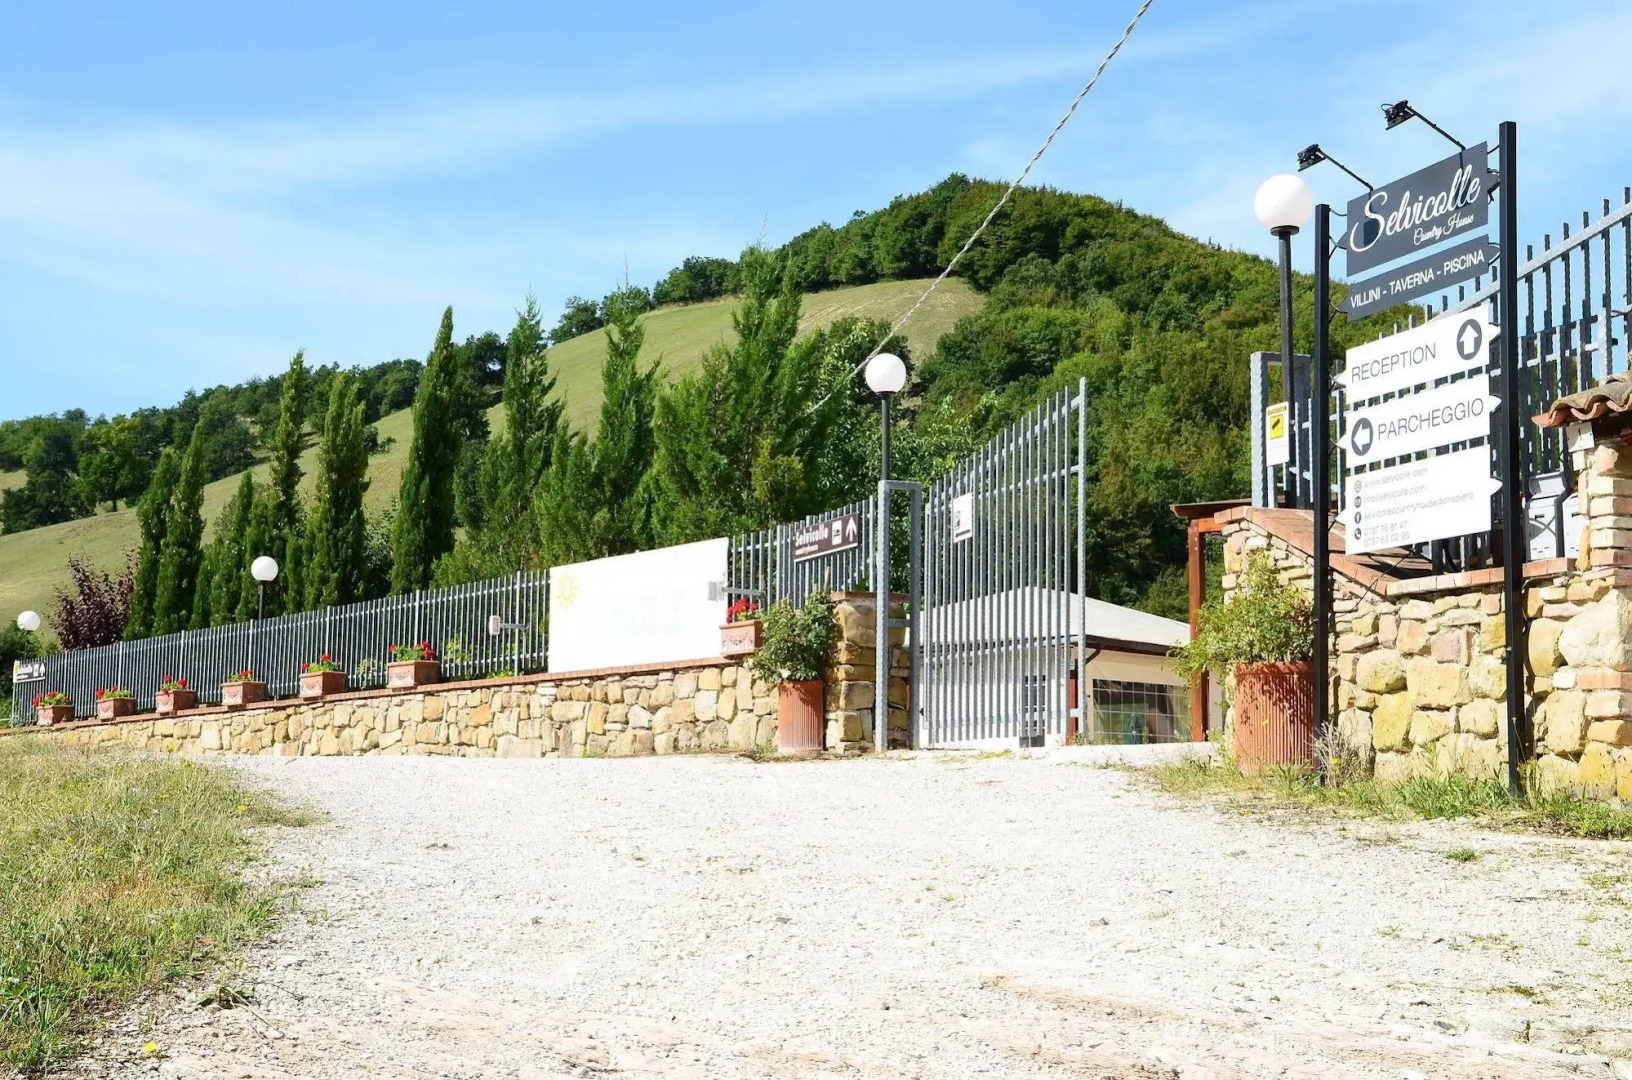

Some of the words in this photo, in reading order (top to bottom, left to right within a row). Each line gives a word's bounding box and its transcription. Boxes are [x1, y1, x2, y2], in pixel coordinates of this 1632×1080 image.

[1350, 163, 1481, 253] Selvicolle
[1413, 225, 1442, 245] Country
[1350, 287, 1381, 309] VILLINI
[1389, 269, 1435, 295] TAVERNA
[1443, 249, 1485, 276] PISCINA
[1351, 342, 1437, 384] RECEPTION
[1378, 397, 1484, 441] PARCHEGGIO
